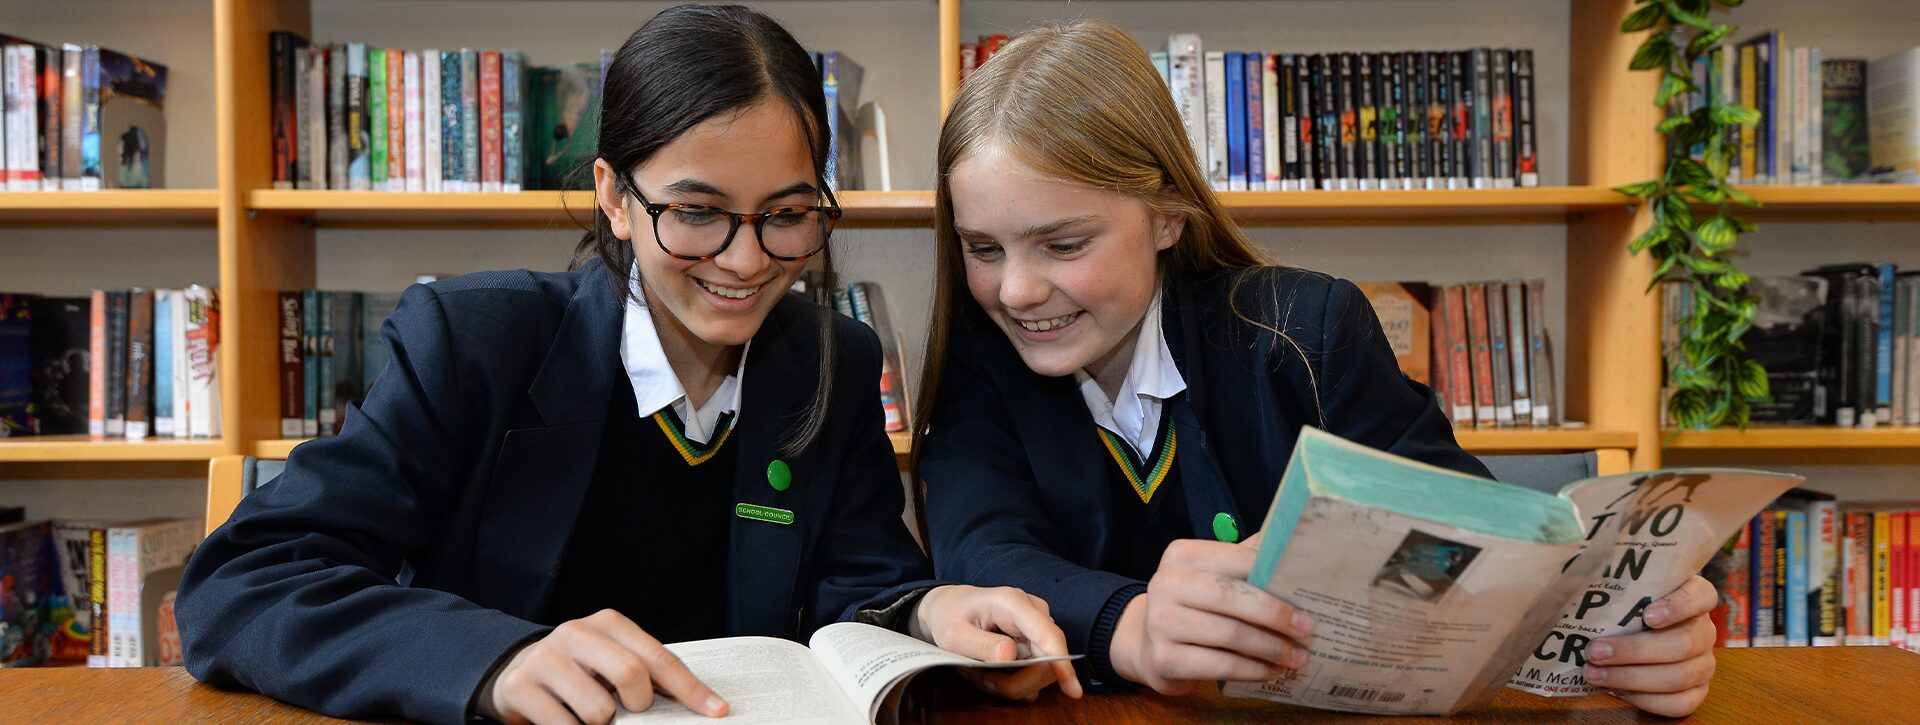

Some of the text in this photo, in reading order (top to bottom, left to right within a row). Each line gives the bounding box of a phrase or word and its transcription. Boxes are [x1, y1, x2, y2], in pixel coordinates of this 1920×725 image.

[282, 297, 300, 363] Seeing Red
[738, 507, 791, 521] SCHOOL COUNCIL
[1822, 508, 1835, 543] PONY
[1577, 624, 1605, 634] back?
[1525, 667, 1542, 682] M.
[1543, 685, 1559, 693] ONE
